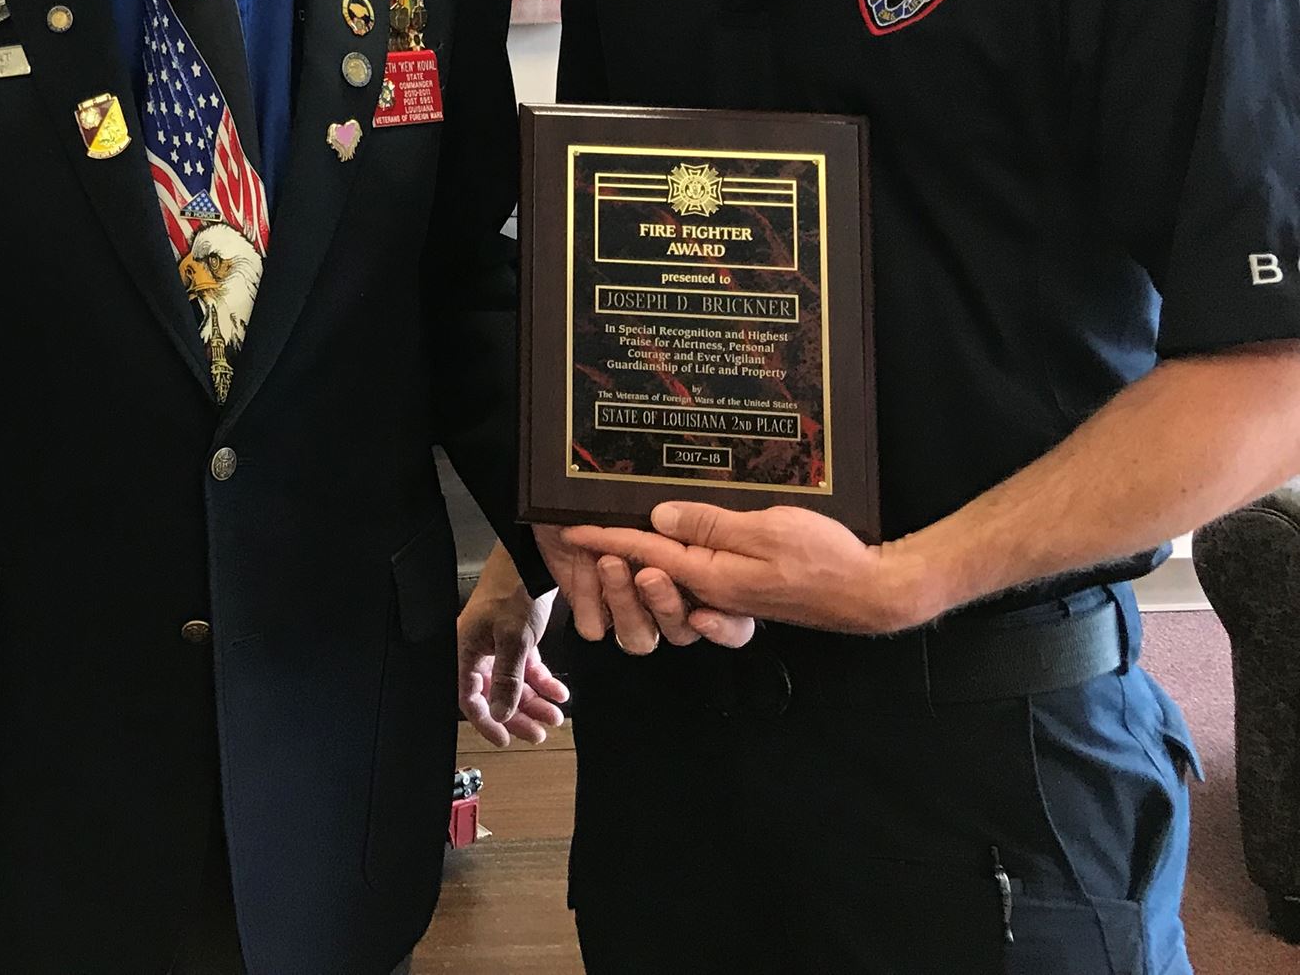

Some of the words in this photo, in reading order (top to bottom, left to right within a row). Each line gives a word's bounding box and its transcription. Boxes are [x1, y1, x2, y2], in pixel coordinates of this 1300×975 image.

[417, 59, 437, 71] KOVAL
[406, 73, 424, 81] STATE
[399, 80, 433, 90] COMMANDER
[404, 89, 431, 97] 2010-2011
[403, 97, 417, 105] POST
[404, 104, 434, 114] LOUISIANA
[376, 115, 400, 124] VETERANS
[401, 114, 408, 122] OF
[409, 113, 429, 121] FOREIGN
[639, 223, 676, 238] FIRE
[682, 225, 753, 241] FIGHTER
[666, 242, 726, 258] AWARD
[661, 272, 715, 285] presented
[719, 275, 731, 285] to
[604, 291, 667, 310] JOSEPH
[703, 297, 793, 316] BRICKNER
[605, 324, 616, 333] In
[618, 324, 656, 336] Special
[659, 326, 722, 339] Recognition
[725, 329, 745, 339] and
[748, 331, 789, 343] Highest
[619, 337, 652, 347] Praise
[654, 338, 669, 348] for
[673, 339, 726, 351] Alertness,
[729, 342, 775, 353] Personal
[627, 348, 671, 361] Courage
[674, 351, 694, 361] and
[697, 352, 721, 363] Ever
[724, 353, 766, 366] Vigilant
[606, 360, 678, 374] Guardianship
[681, 363, 693, 373] of
[695, 364, 715, 375] Life
[718, 365, 738, 376] and
[741, 367, 787, 380] Property
[692, 384, 702, 394] by
[598, 390, 613, 399] The
[616, 391, 649, 401] Veterans
[651, 393, 661, 402] of
[662, 394, 693, 405] Foreign
[694, 395, 714, 405] Wars
[717, 396, 727, 405] of
[728, 397, 741, 406] the
[744, 398, 770, 408] United
[772, 400, 798, 410] States
[602, 408, 638, 424] STATE
[642, 410, 657, 425] OF
[663, 411, 727, 430] LOUISIANA
[757, 418, 794, 434] PLACE
[675, 451, 721, 464] 2017-18
